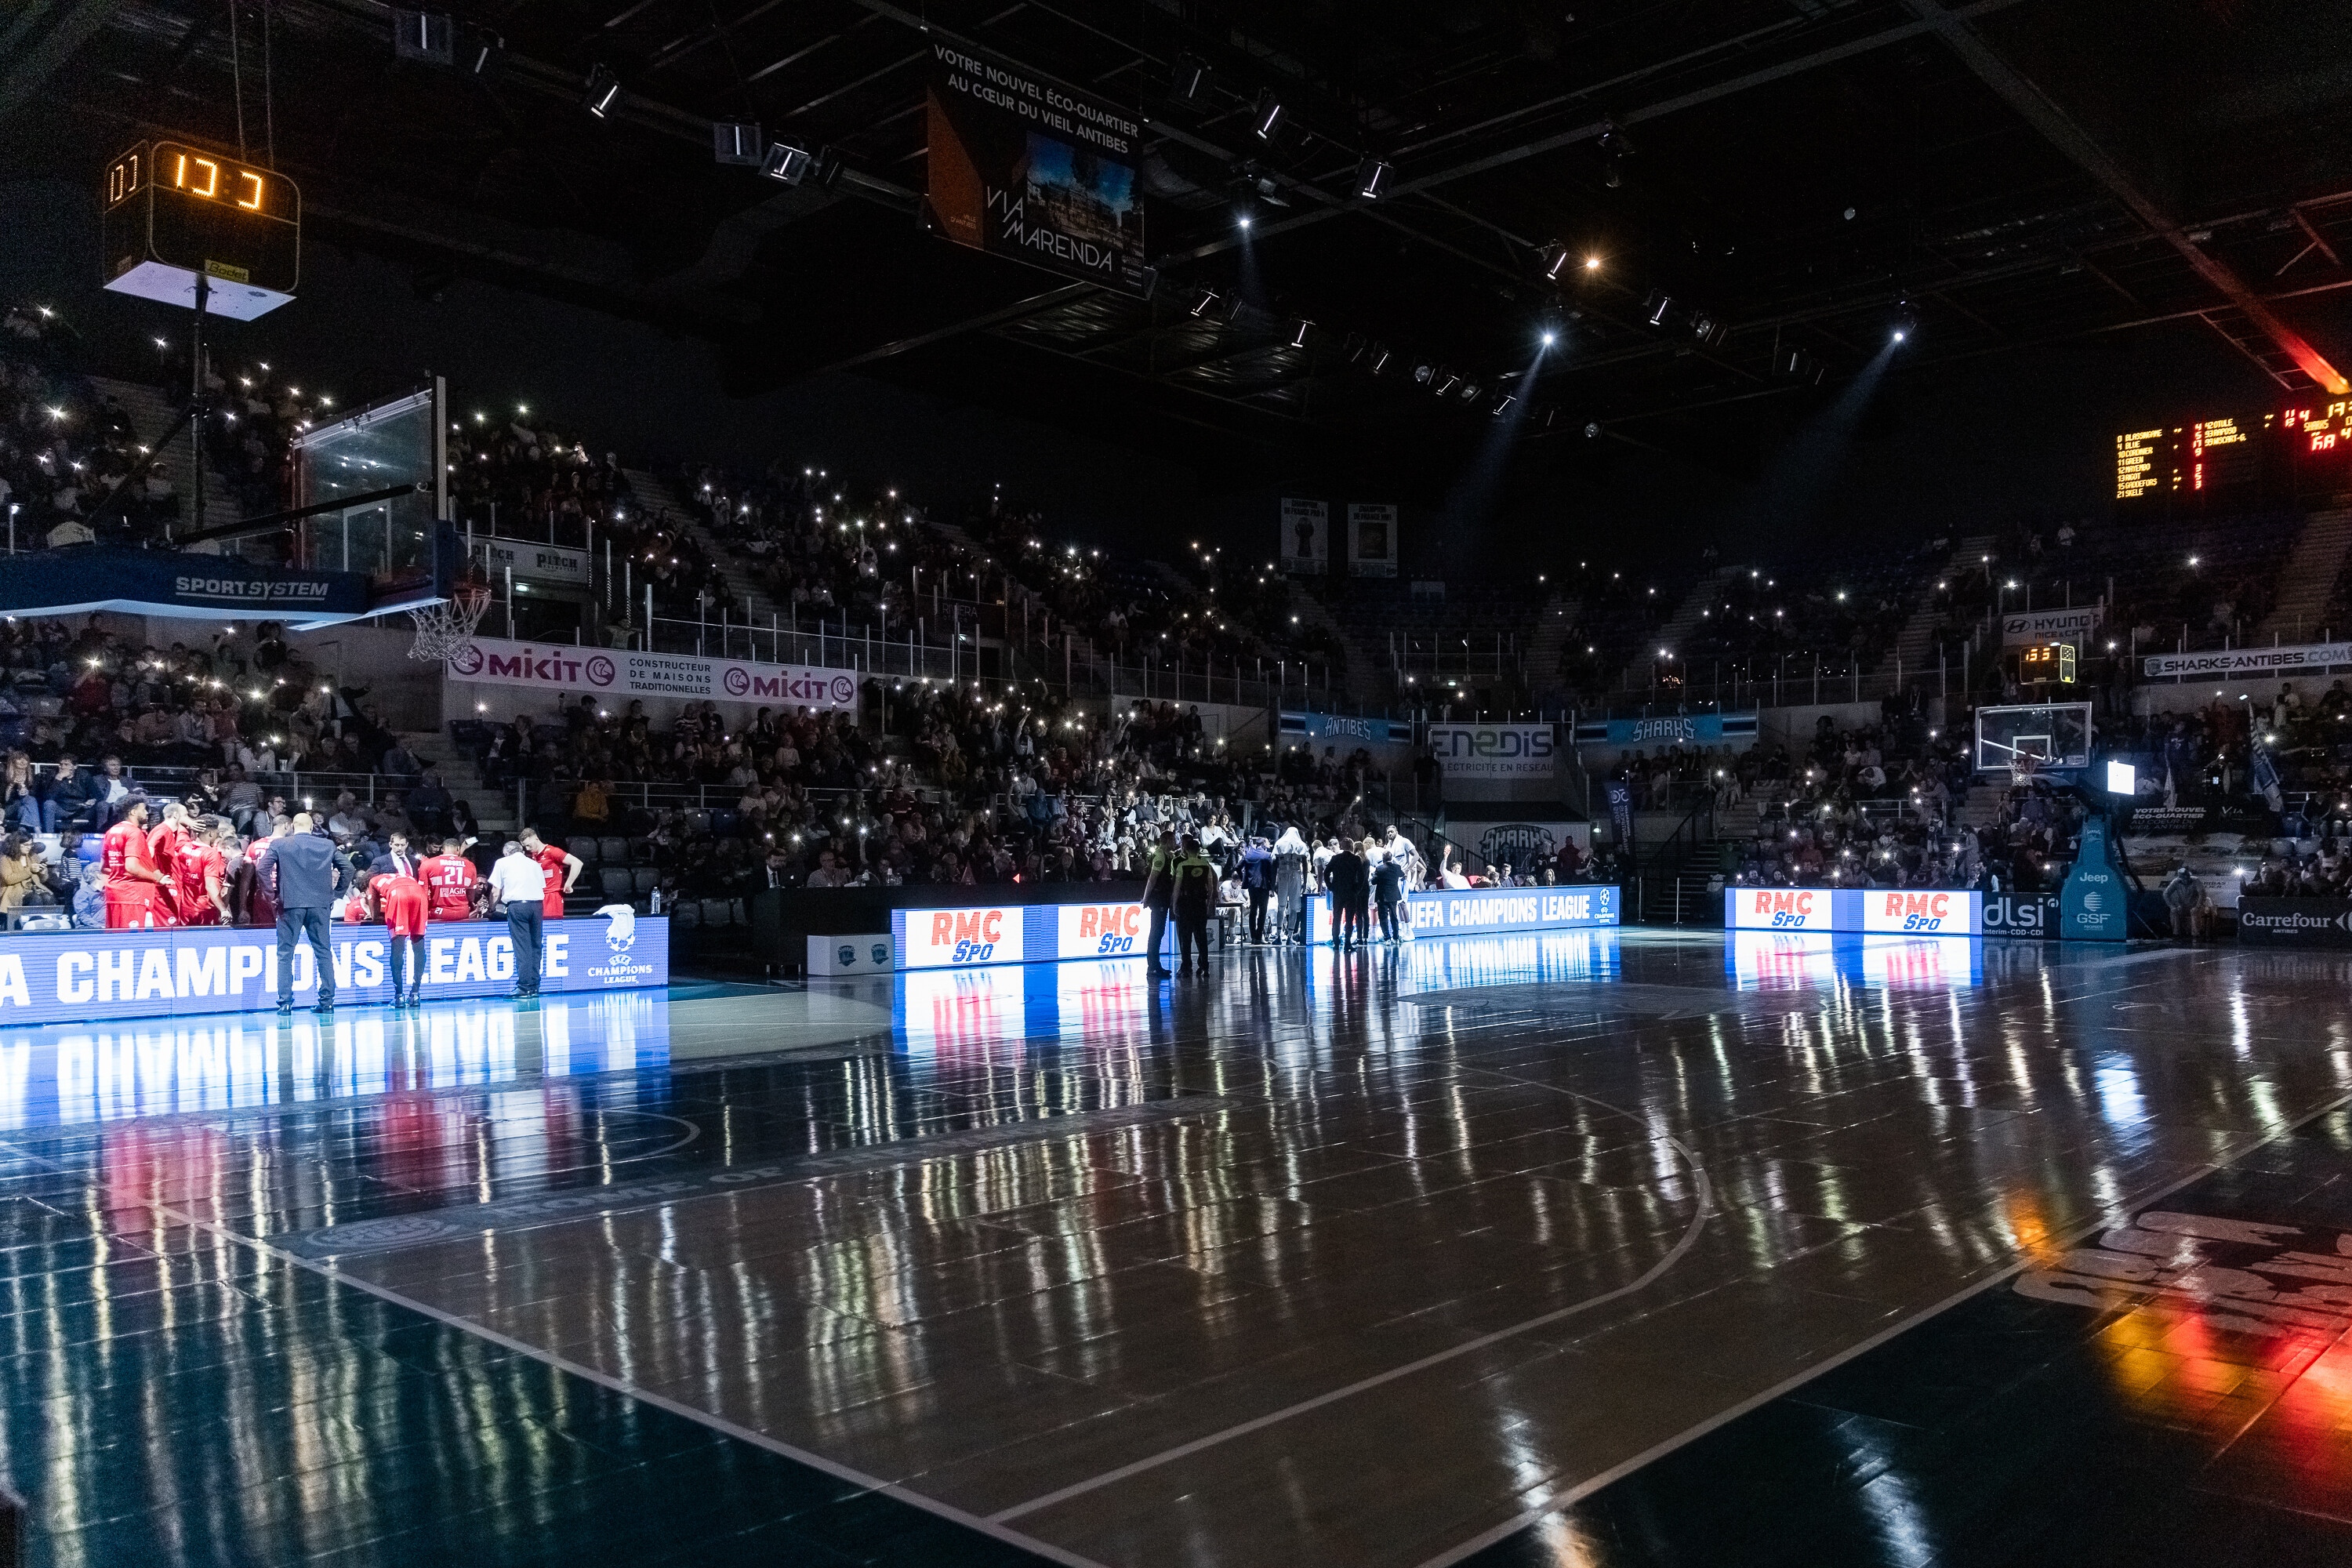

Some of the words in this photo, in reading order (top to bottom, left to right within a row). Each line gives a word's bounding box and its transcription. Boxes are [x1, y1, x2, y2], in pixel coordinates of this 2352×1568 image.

[935, 44, 982, 77] VOTRE
[986, 66, 1042, 102] NOUVEL
[1047, 89, 1139, 138] ÉCO-QUARTIER
[947, 74, 968, 93] AU
[1018, 100, 1037, 120] DU
[1041, 110, 1073, 134] VIEIL
[1076, 125, 1129, 154] ANTIBES
[988, 186, 1023, 223] VIA
[1004, 220, 1112, 272] MARENDA
[209, 262, 247, 281] Bodet
[2125, 440, 2140, 450] BLUE
[2125, 456, 2143, 466] GREEN
[2118, 474, 2125, 483] 13
[2125, 472, 2141, 481] RIGOT
[2117, 490, 2125, 499] 21
[2125, 488, 2143, 497] SKELE
[536, 553, 578, 568] PITCH
[630, 658, 712, 673] CONSTRUCTEUR
[630, 670, 645, 679] DE
[654, 672, 712, 684] MAISONS
[630, 681, 712, 695] TRADITIONNELLES
[1326, 716, 1372, 741] ANTIBES
[1631, 717, 1695, 742] SHARKS
[1501, 764, 1512, 772] EN
[445, 866, 463, 885] 21
[2079, 872, 2109, 884] Jeep
[1449, 897, 1537, 927] CHAMPIONS
[1541, 895, 1590, 922] LEAGUE
[1755, 891, 1813, 916] RMC
[1885, 893, 1950, 918] RMC
[1983, 897, 2044, 927] dlsi
[931, 909, 1003, 946] RMC
[1079, 906, 1141, 938] RMC
[2077, 913, 2111, 924] GSF
[2241, 912, 2331, 928] Carrefour
[56, 941, 385, 1004] CHAMPIONS
[587, 964, 653, 978] CHAMPIONS
[604, 975, 640, 984] LEAGUE
